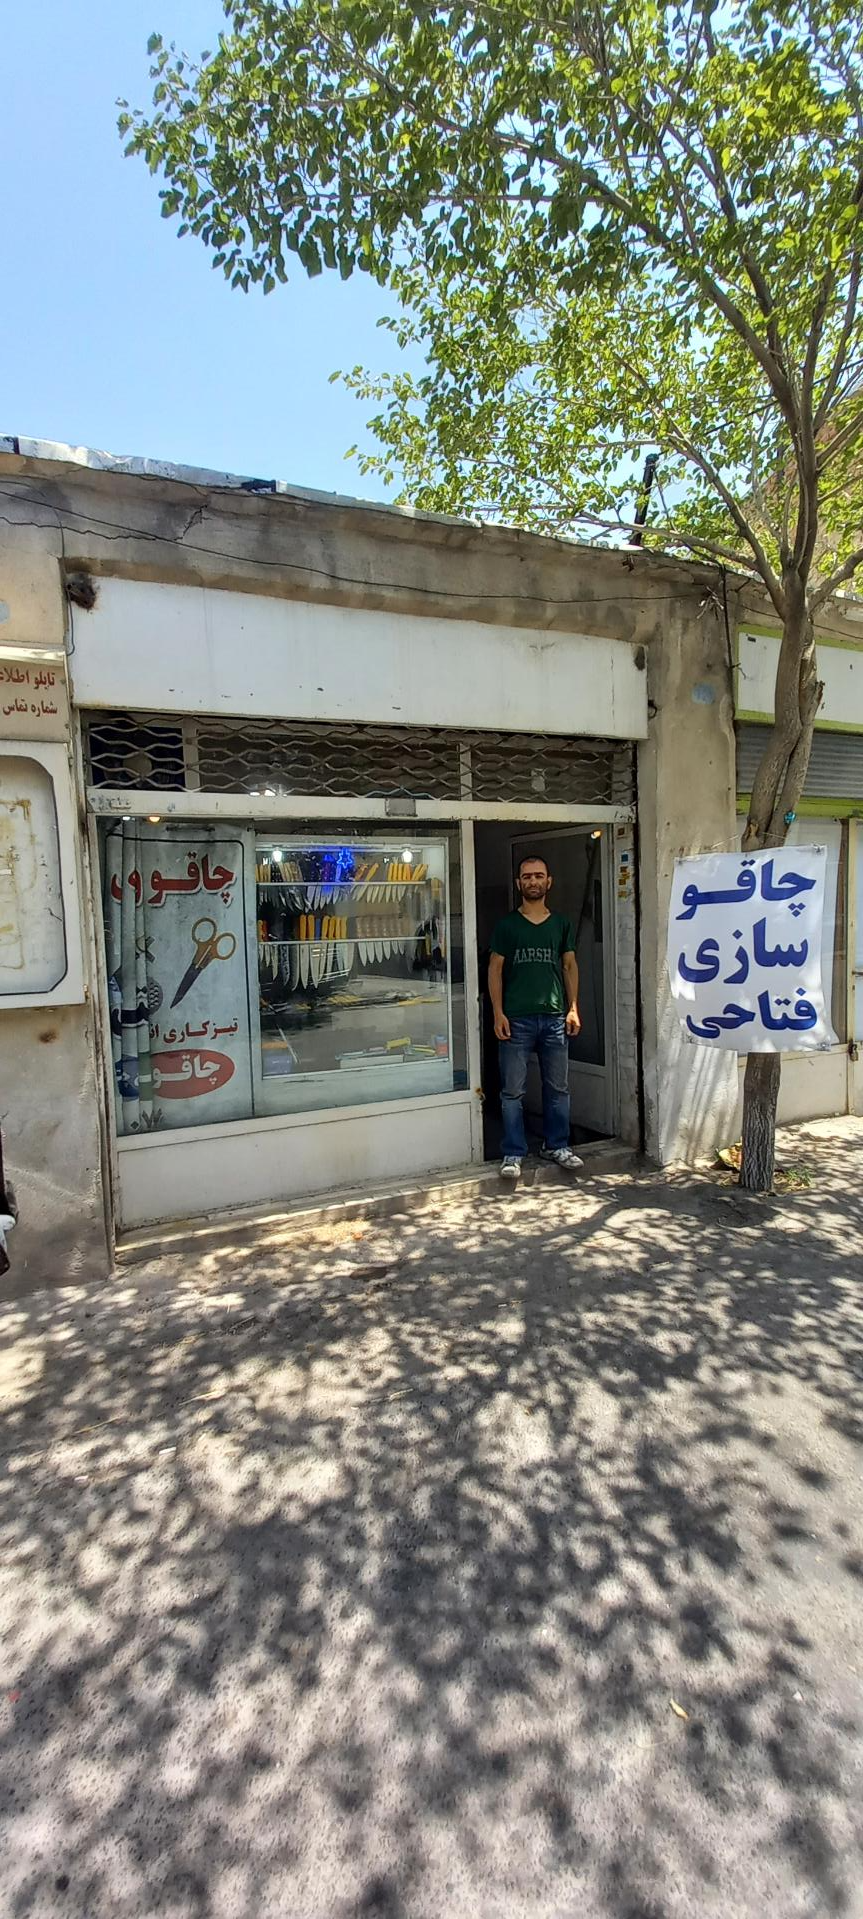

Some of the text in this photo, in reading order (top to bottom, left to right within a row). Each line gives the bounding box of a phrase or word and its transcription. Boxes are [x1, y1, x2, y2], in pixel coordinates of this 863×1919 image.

[33, 671, 56, 690] تابلو
[2, 698, 58, 718] شماره تماس
[147, 851, 236, 906] چاقو
[675, 858, 817, 920] چاقو
[512, 946, 557, 966] MARSH
[677, 916, 809, 984] سازی
[686, 987, 818, 1039] فتاحی
[152, 1054, 221, 1086] چاقو
